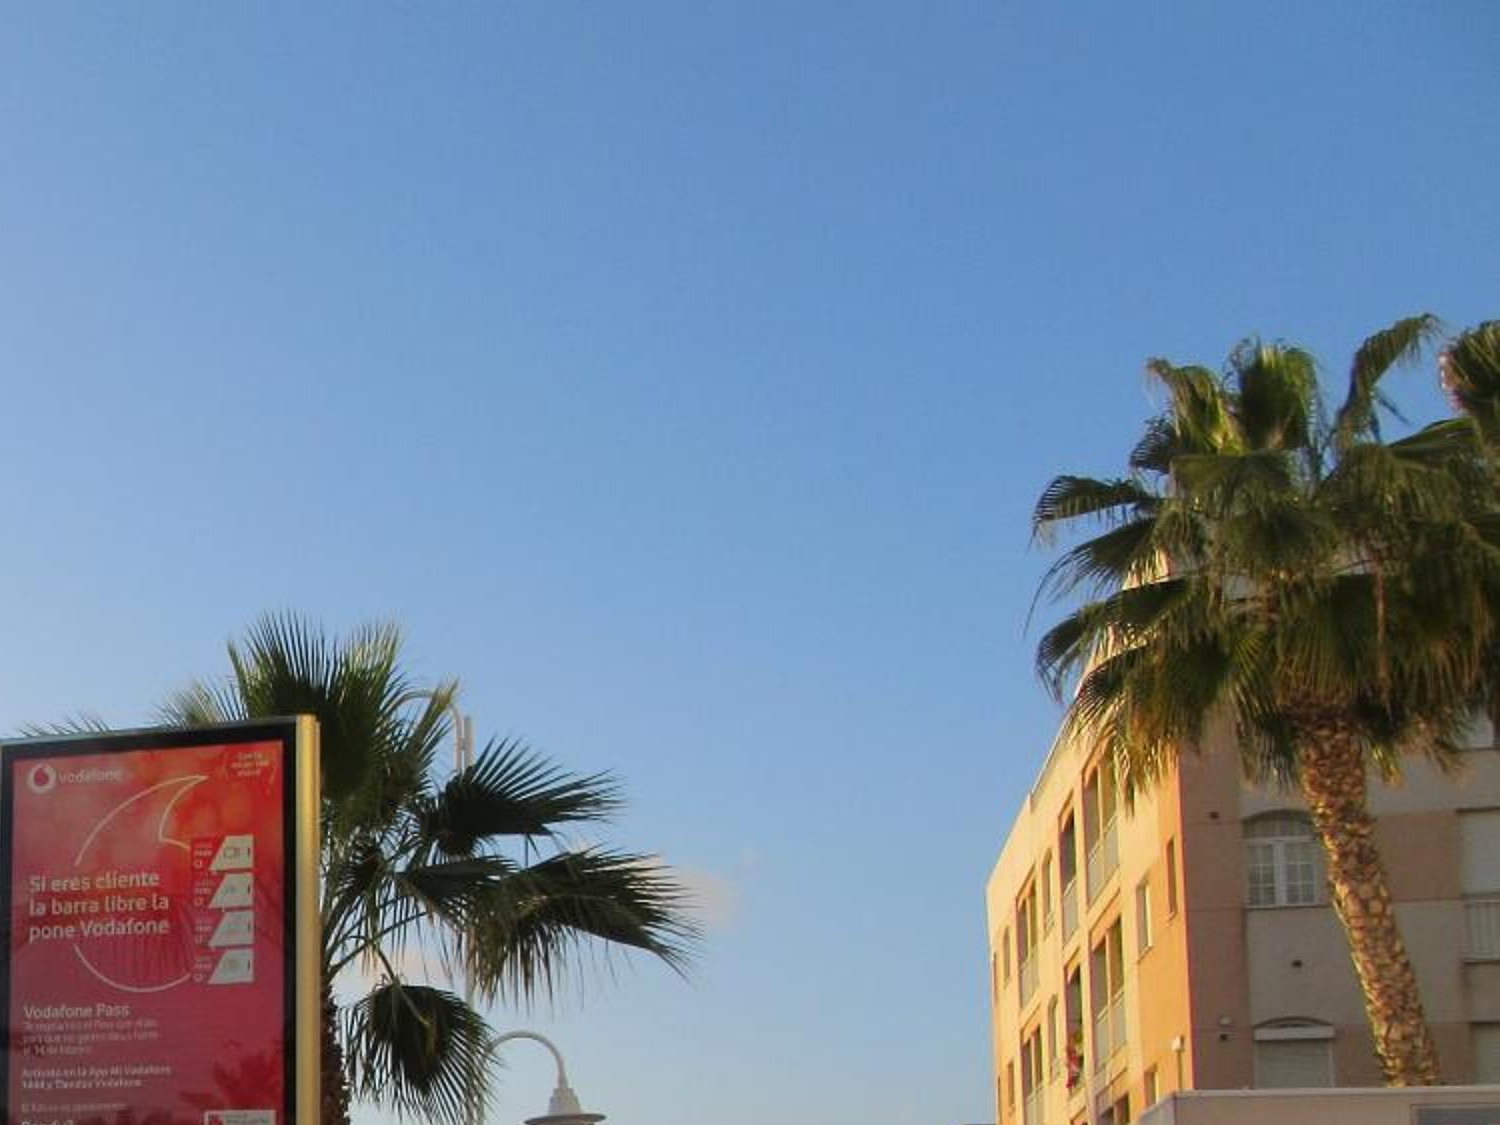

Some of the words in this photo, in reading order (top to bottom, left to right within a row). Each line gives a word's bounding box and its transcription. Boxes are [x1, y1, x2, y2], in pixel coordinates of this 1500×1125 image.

[29, 875, 48, 892] Si
[51, 876, 91, 891] eres
[96, 871, 160, 888] cliente
[29, 900, 48, 916] la
[51, 898, 100, 915] barra
[104, 895, 148, 912] libre
[152, 894, 169, 911] la
[29, 923, 77, 943] pone
[80, 918, 169, 936] Vodafone
[23, 1005, 93, 1018] Vodafone
[96, 1003, 130, 1017] Pass
